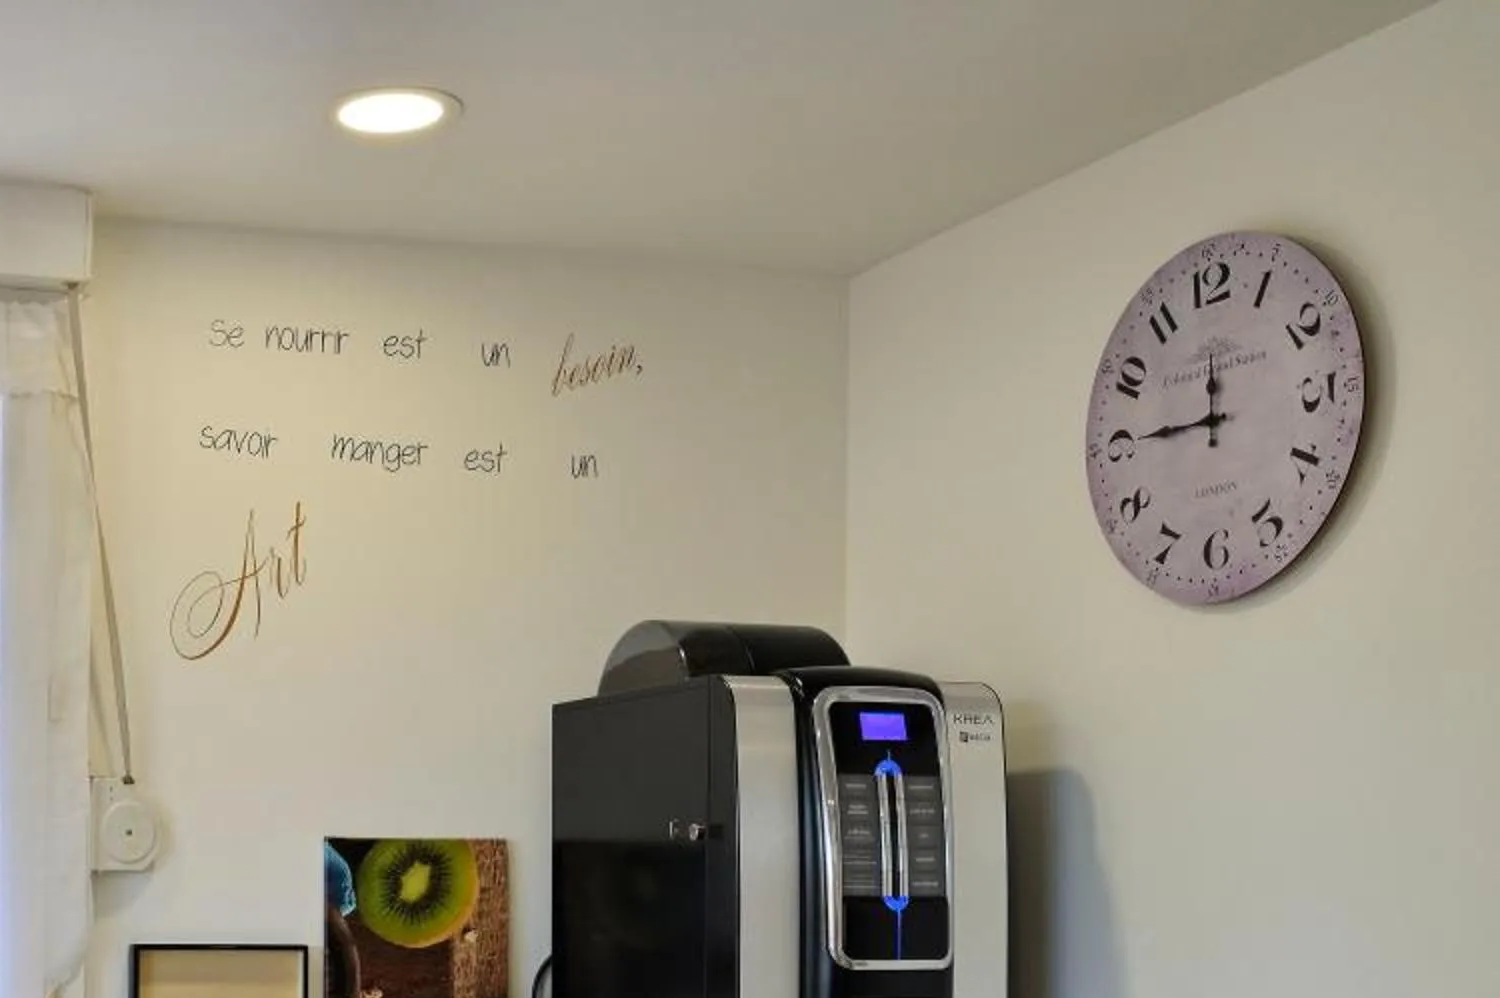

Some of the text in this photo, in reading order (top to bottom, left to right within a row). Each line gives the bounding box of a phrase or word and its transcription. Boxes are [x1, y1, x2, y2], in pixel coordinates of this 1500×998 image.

[1193, 261, 1231, 309] 12
[1254, 269, 1273, 309] 1
[1149, 301, 1178, 345] 11
[1285, 302, 1321, 350] 2
[382, 327, 428, 359] est
[480, 342, 511, 369] un
[1116, 356, 1147, 399] 10
[1301, 371, 1337, 413] 3
[199, 425, 599, 479] savoir manger est un
[1108, 429, 1136, 462] 9
[1289, 444, 1320, 487] 4
[1119, 486, 1151, 525] 8
[1251, 497, 1284, 547] 5
[1154, 522, 1183, 565] 7
[1203, 529, 1230, 570] 6
[169, 501, 307, 661] Art
